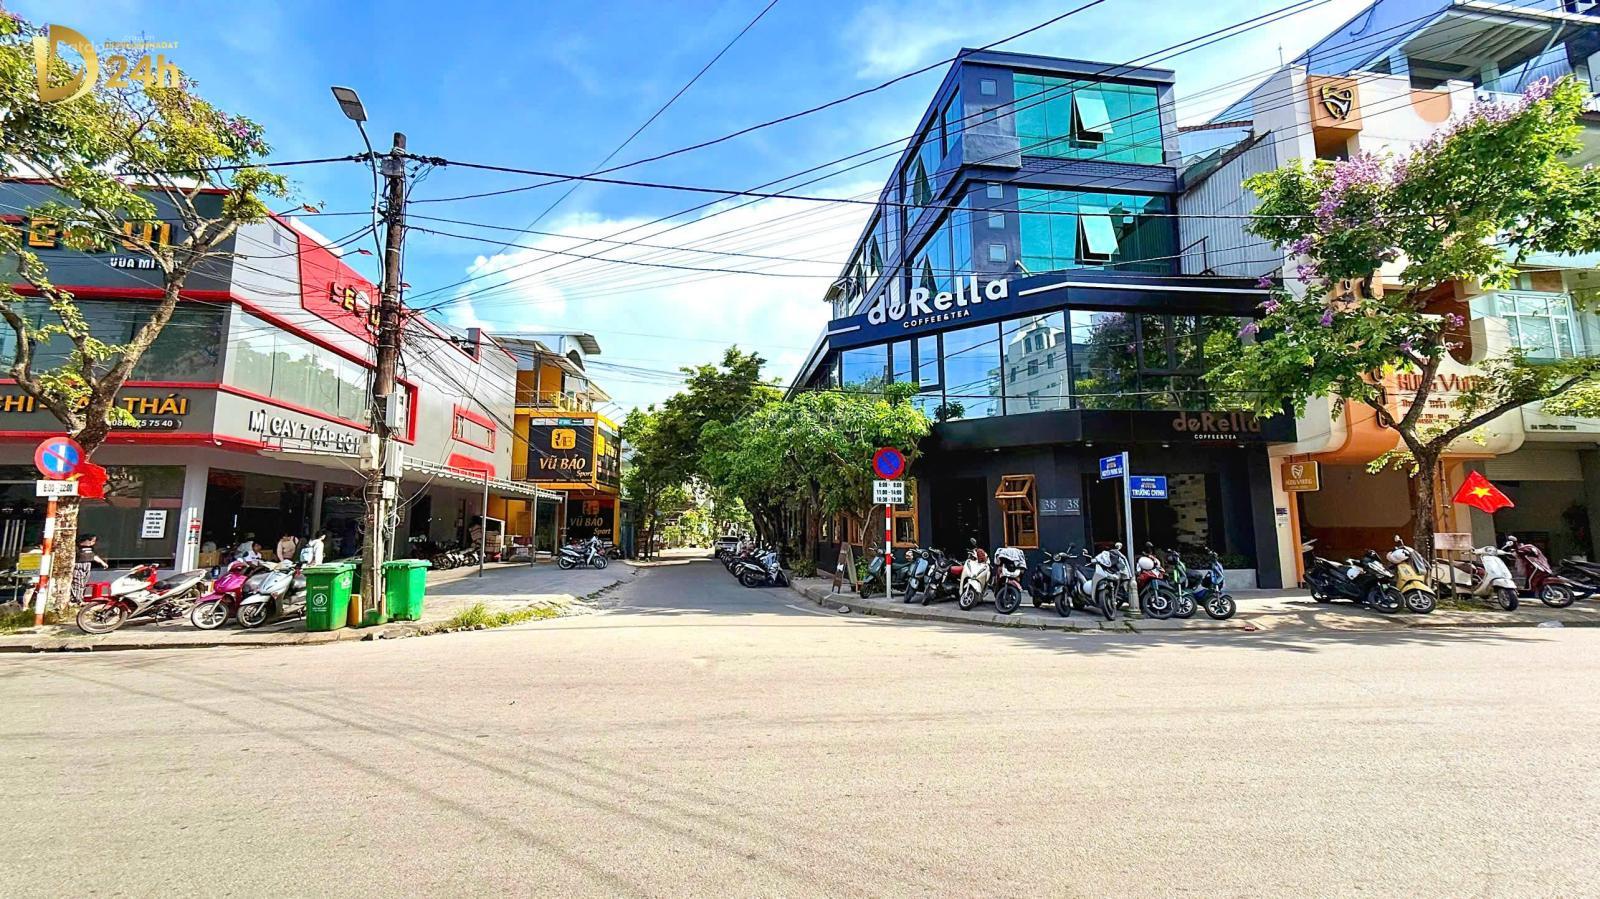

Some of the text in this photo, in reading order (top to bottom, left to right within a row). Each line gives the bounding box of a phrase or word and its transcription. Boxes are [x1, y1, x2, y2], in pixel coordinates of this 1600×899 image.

[867, 273, 1009, 325] deRella
[903, 309, 971, 328] COFFEE&TEA
[122, 393, 188, 415] THÁI
[149, 419, 160, 427] 75
[162, 419, 173, 427] 40
[248, 409, 268, 433] MÌ
[270, 416, 299, 438] CAY
[301, 423, 310, 441] 7
[1172, 411, 1262, 433] deRella
[540, 454, 586, 470] VŨ BẢO
[1044, 499, 1080, 510] 38 38
